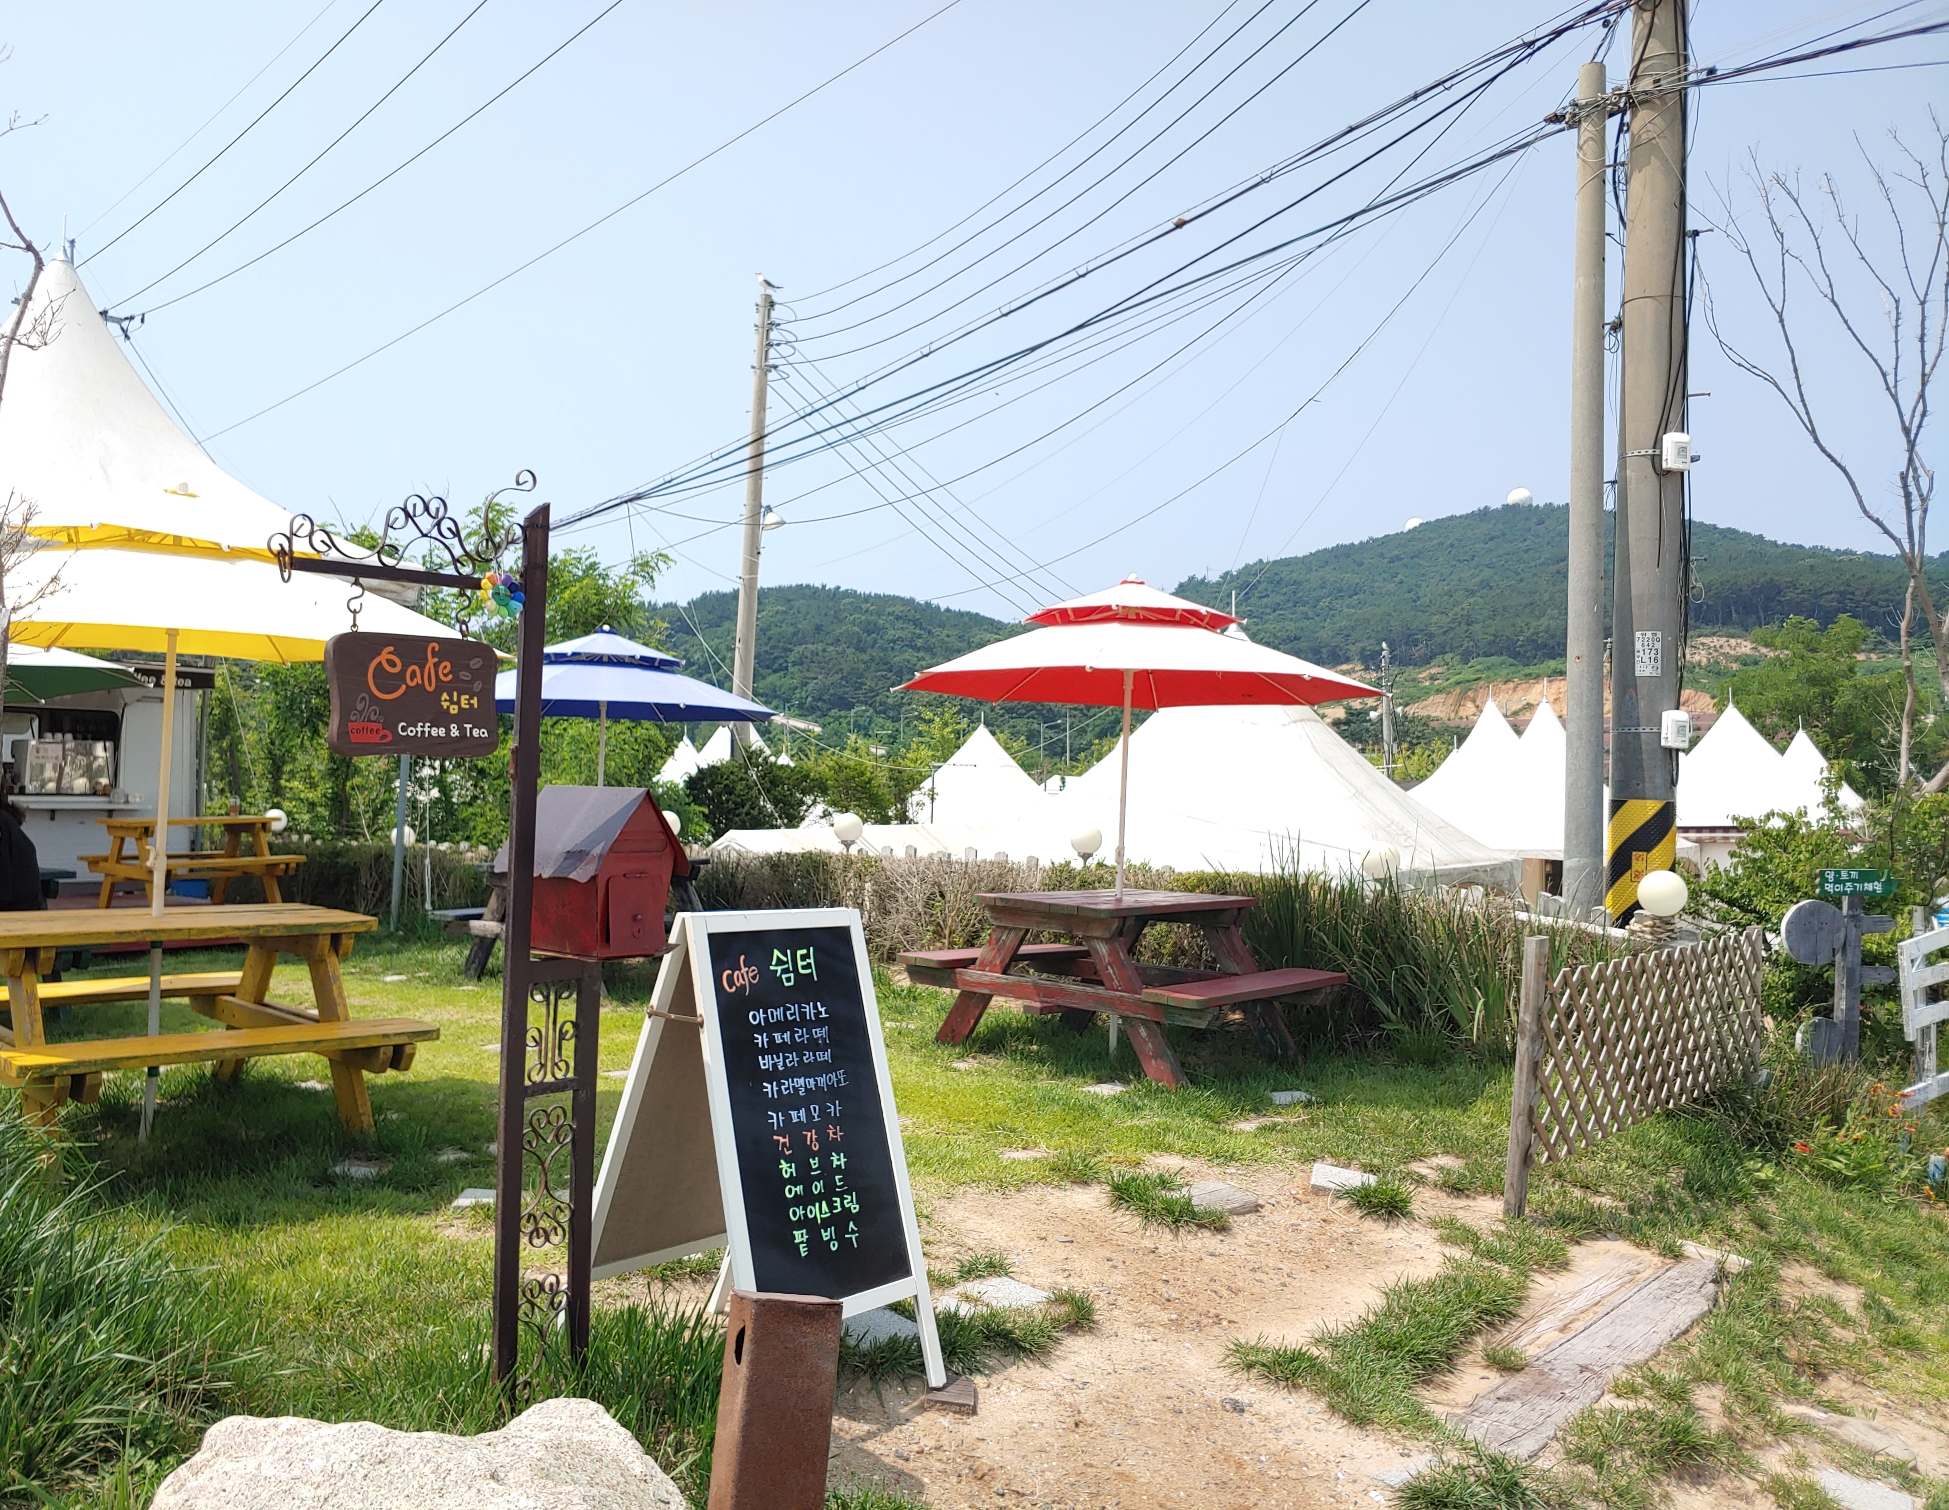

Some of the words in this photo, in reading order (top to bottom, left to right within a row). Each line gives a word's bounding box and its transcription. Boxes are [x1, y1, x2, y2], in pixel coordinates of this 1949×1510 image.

[367, 641, 453, 700] Cafe
[440, 691, 478, 715] 쉼터
[350, 725, 381, 735] coffee
[397, 721, 447, 738] Coffee
[449, 725, 461, 738] &
[463, 724, 489, 738] Tea
[769, 946, 818, 987] 쉼터
[748, 1001, 830, 1027] 아메리카노
[789, 1191, 860, 1224] 아이스크림
